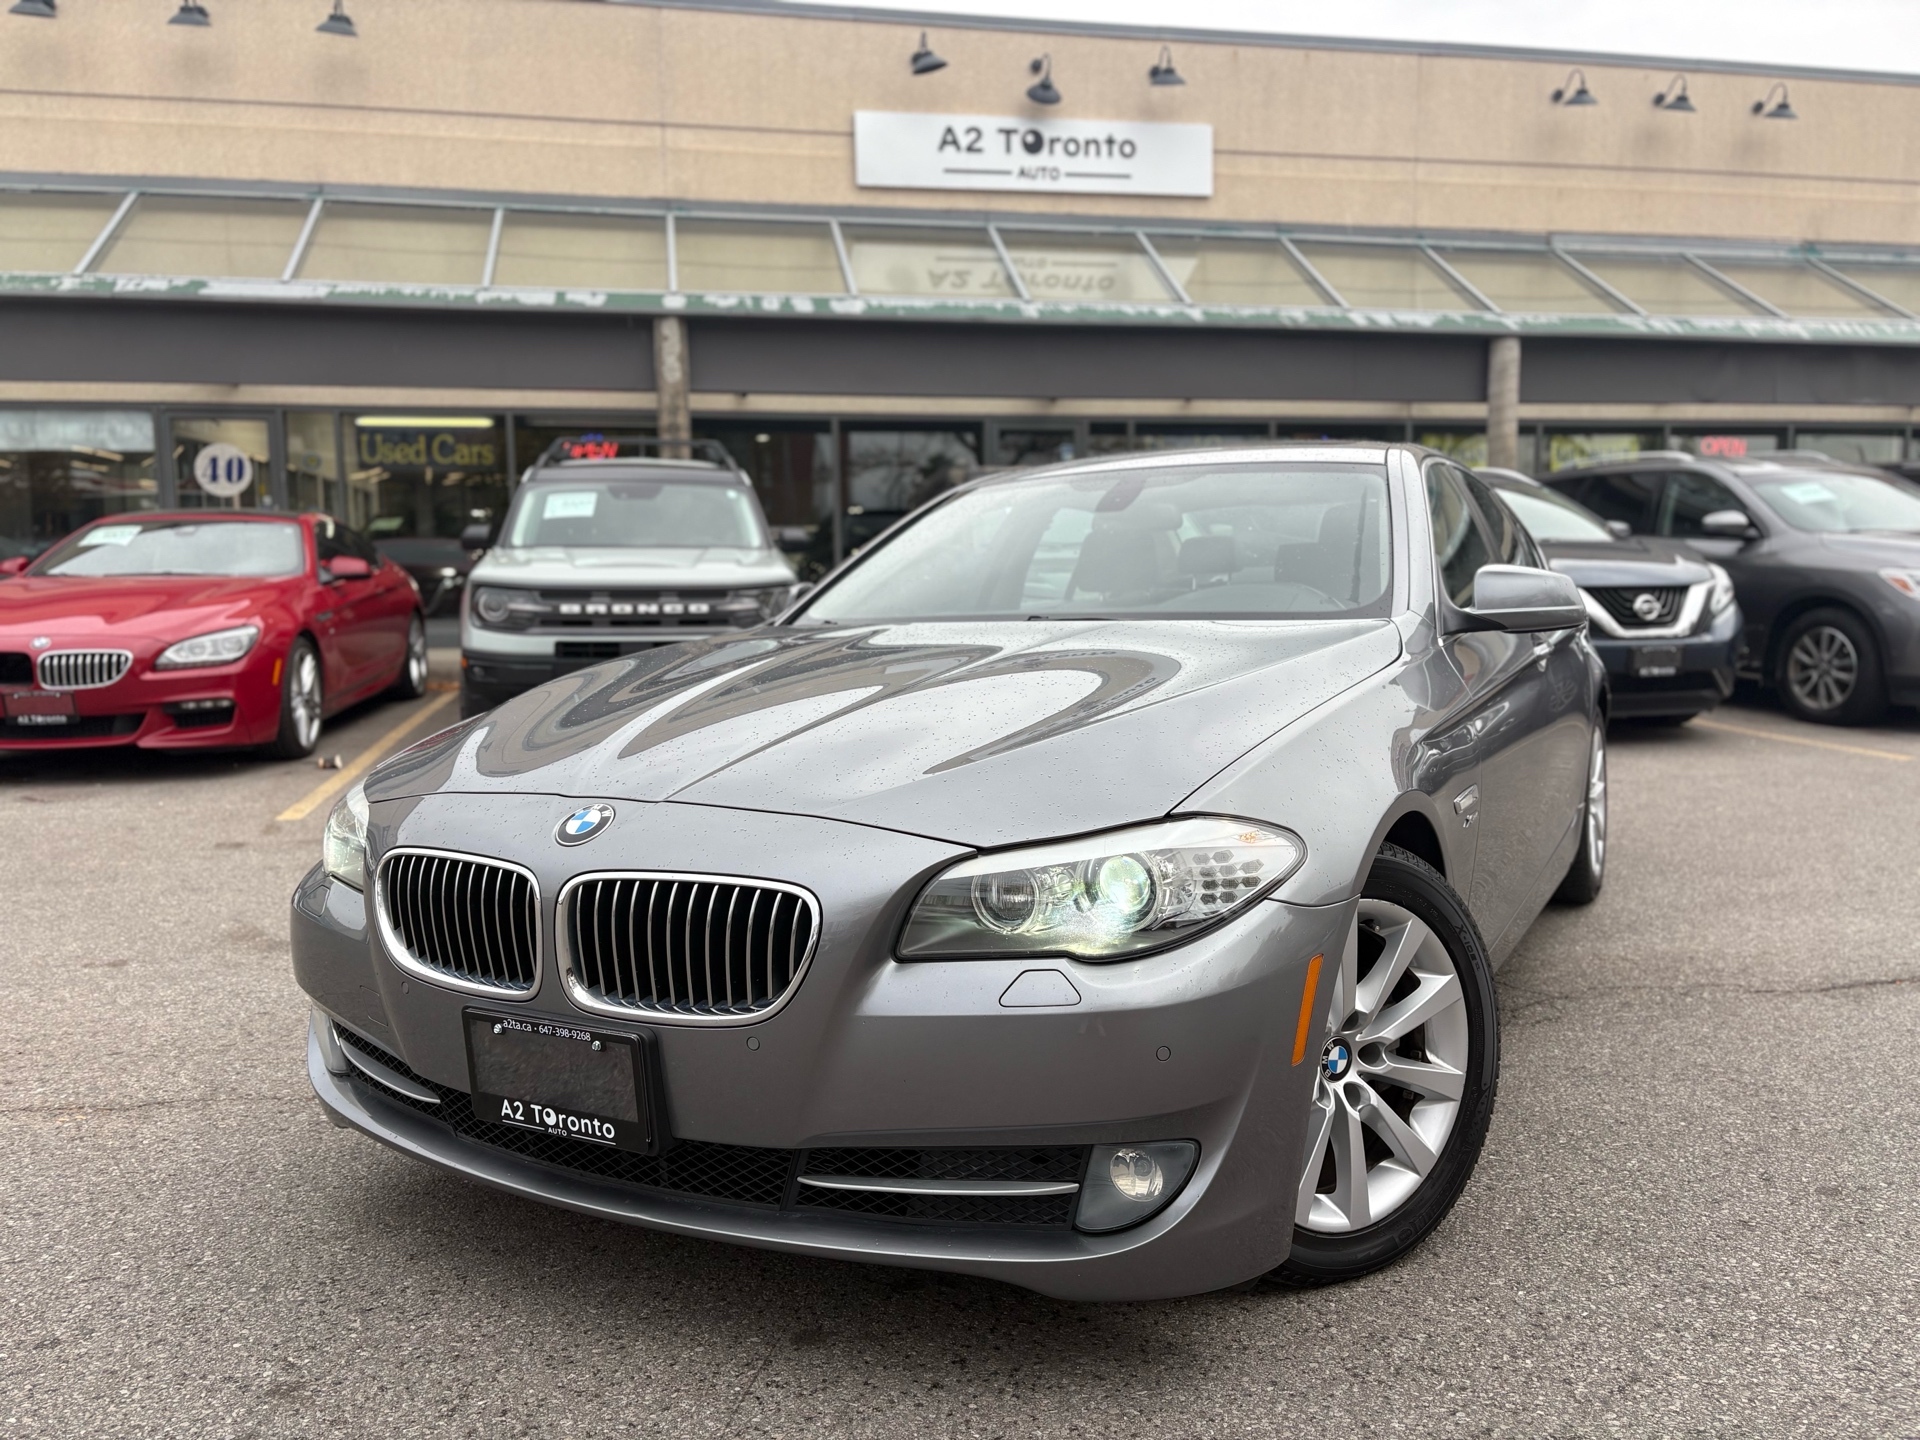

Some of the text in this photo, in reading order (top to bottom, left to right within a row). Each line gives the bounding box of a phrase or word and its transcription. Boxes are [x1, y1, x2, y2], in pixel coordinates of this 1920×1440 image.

[938, 126, 1137, 159] A2 Toronto
[1017, 167, 1060, 181] AUTO
[360, 433, 495, 466] Used Cars
[1700, 435, 1747, 457] OPEN
[201, 455, 245, 483] 40
[559, 603, 710, 615] BRONCO
[503, 1019, 591, 1041] a2ta.ca 647-398-9268
[501, 1099, 615, 1139] A2 Toronto
[548, 1127, 567, 1137] AUTO
